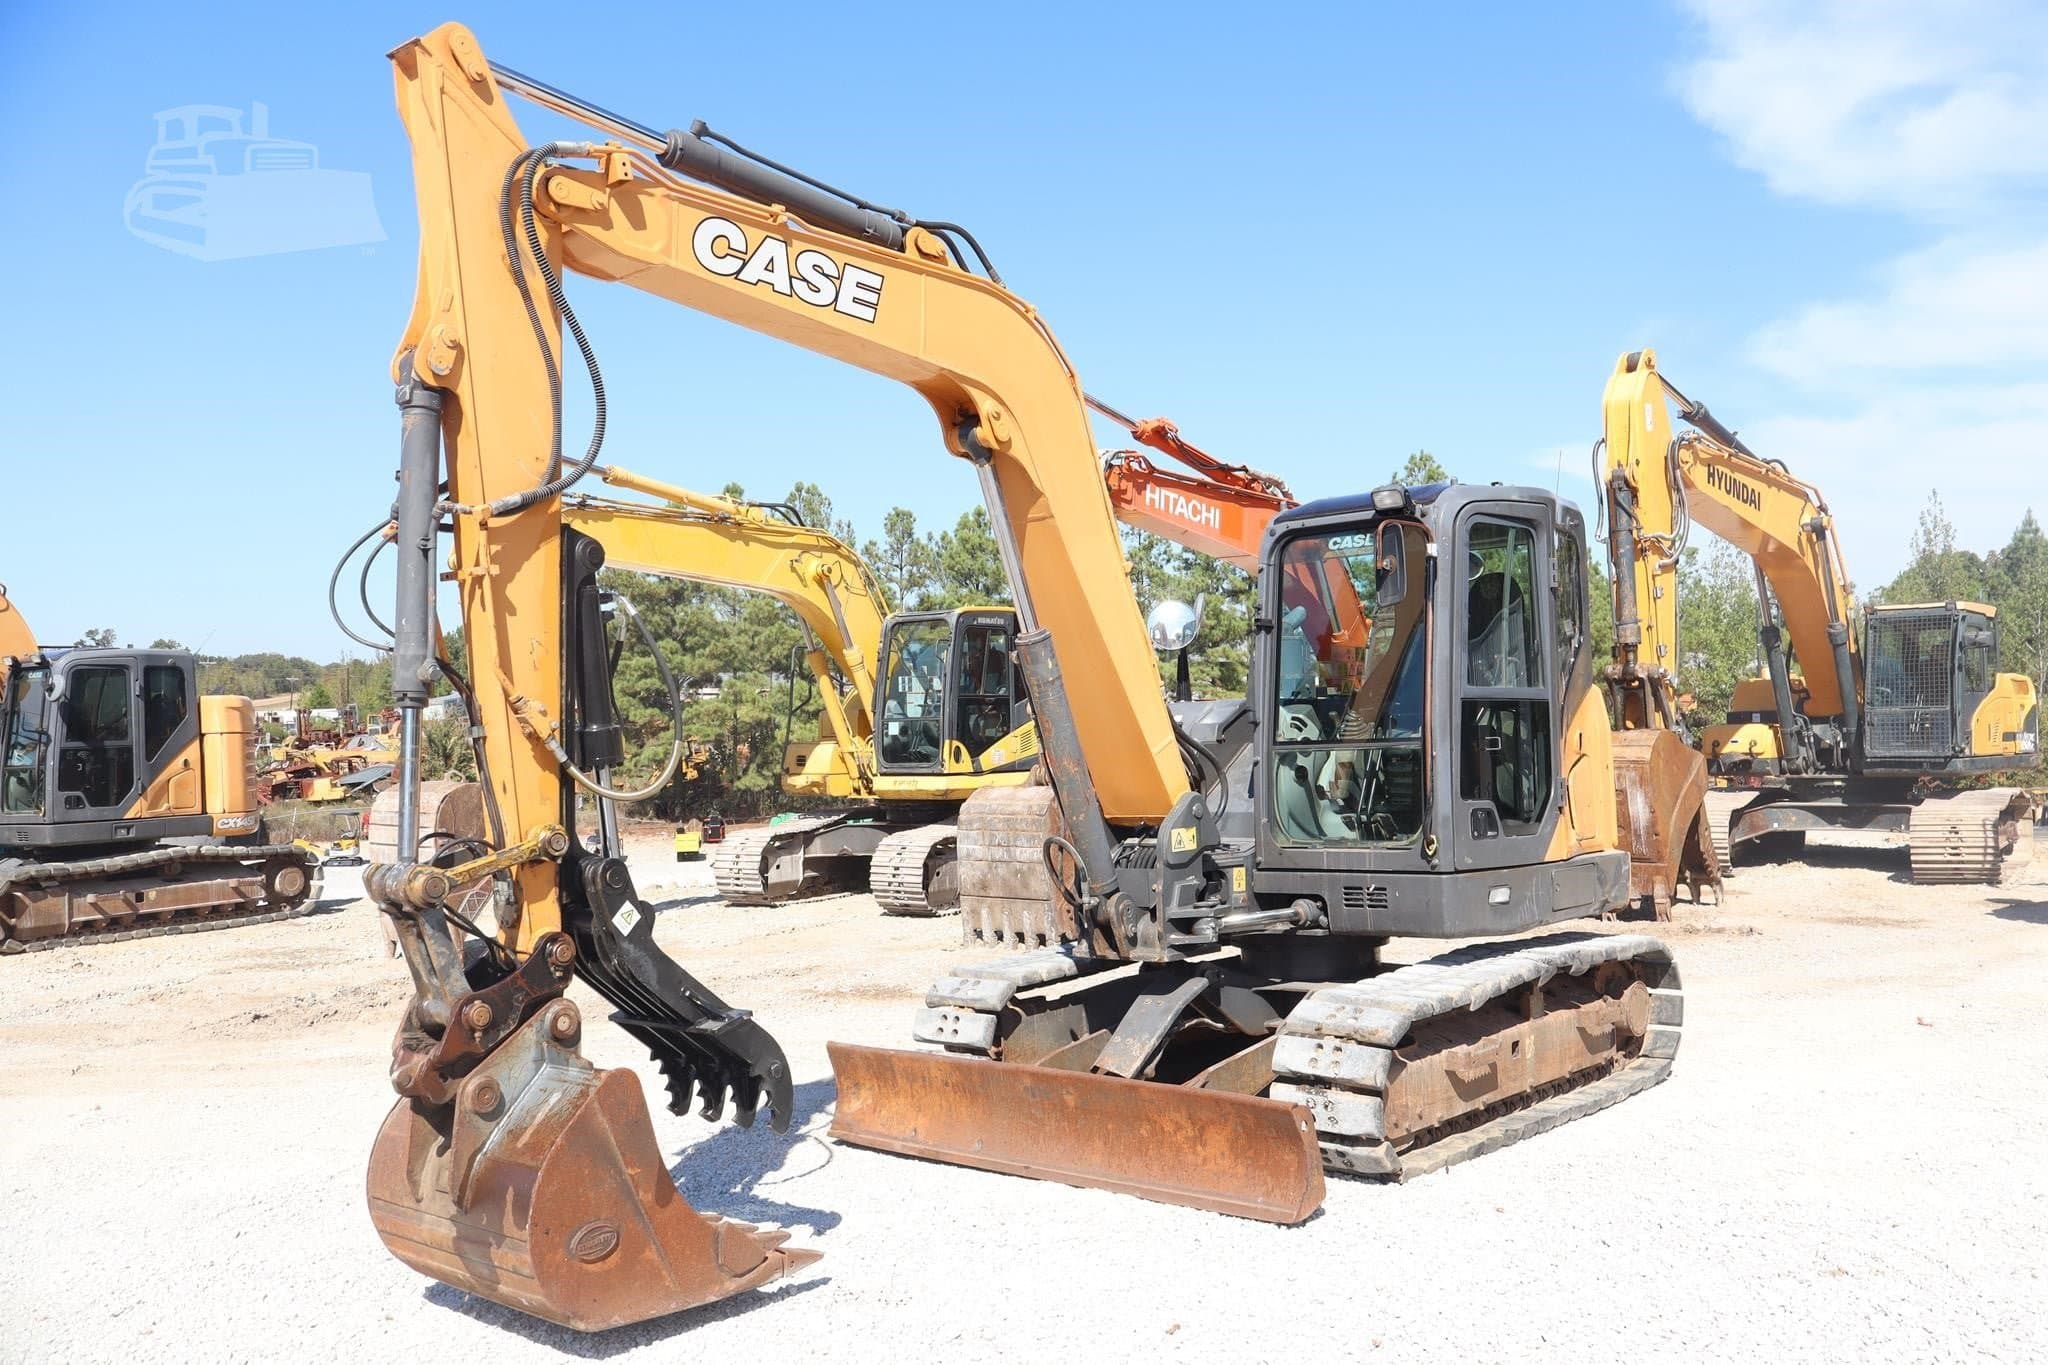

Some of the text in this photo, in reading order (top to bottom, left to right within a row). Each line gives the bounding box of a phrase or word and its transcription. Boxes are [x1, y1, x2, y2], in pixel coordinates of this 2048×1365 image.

[692, 216, 885, 324] CASE
[1145, 484, 1220, 529] HITACHI
[1707, 463, 1761, 512] HYUNDAI
